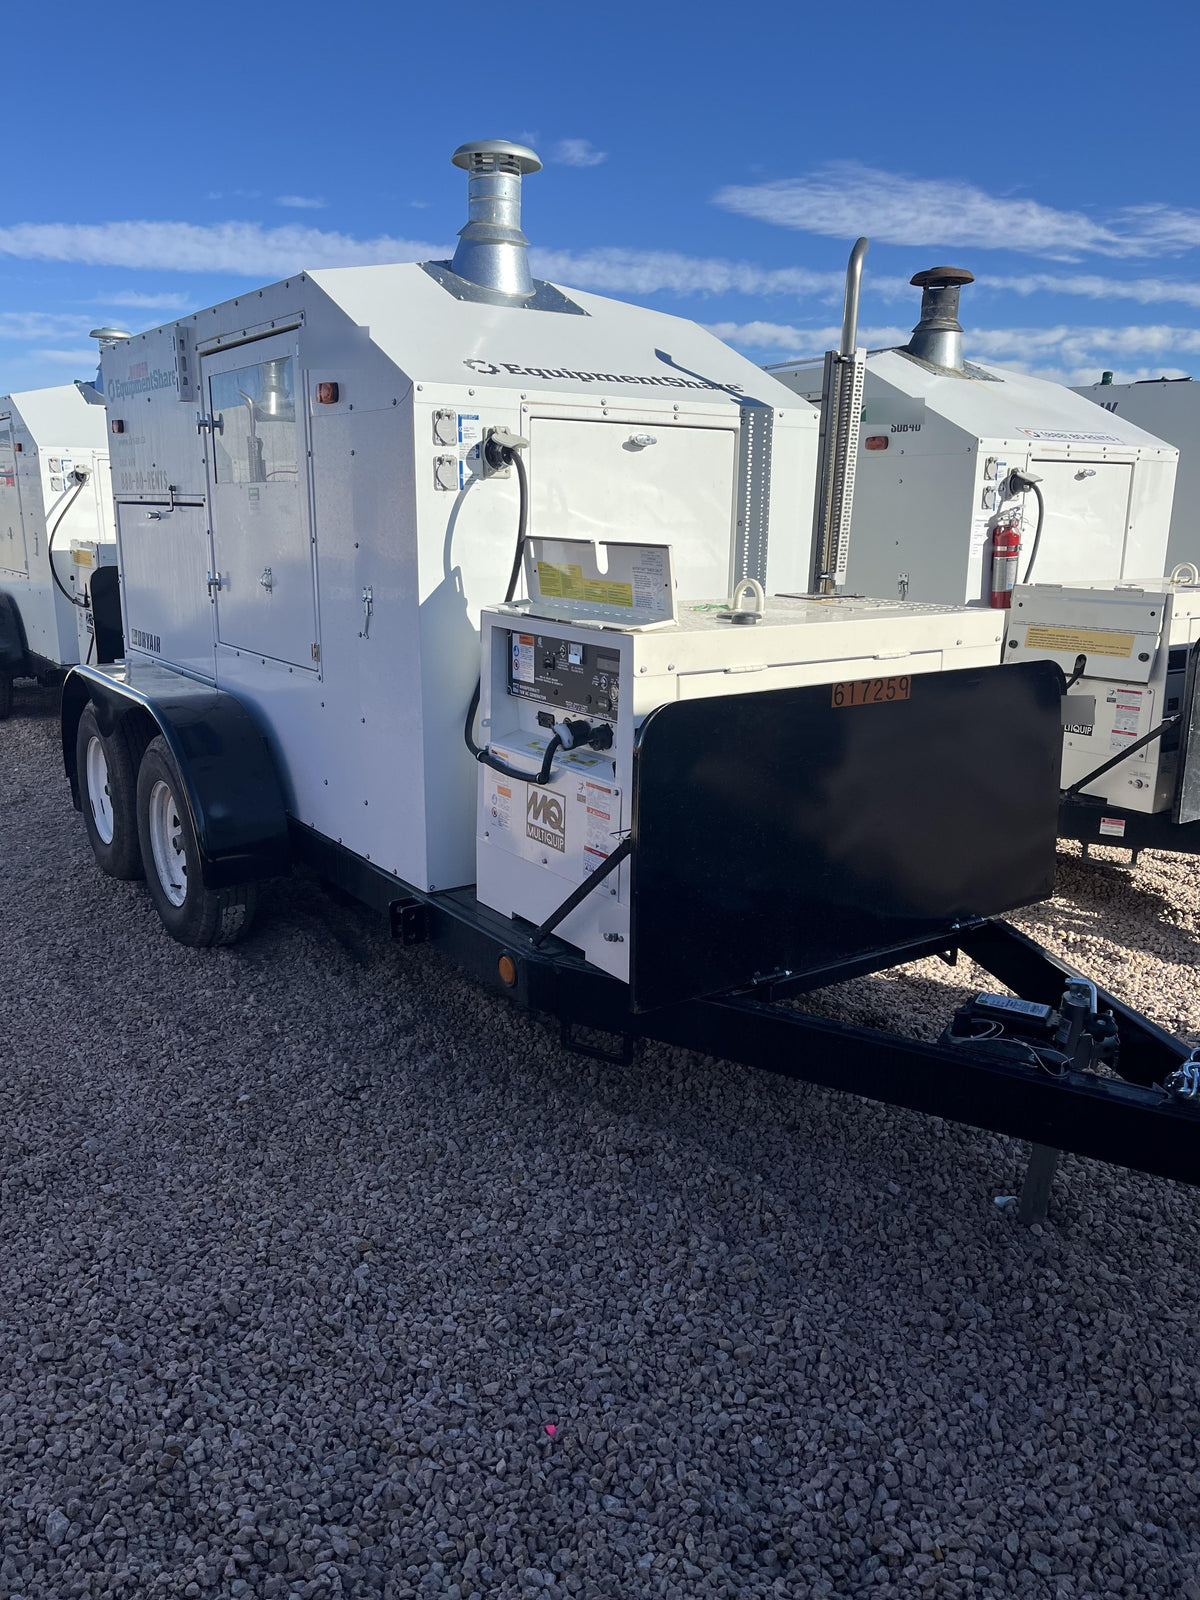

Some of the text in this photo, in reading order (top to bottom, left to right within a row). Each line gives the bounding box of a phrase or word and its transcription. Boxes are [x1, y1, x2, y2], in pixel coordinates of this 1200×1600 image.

[115, 369, 177, 400] EquipmentShare
[500, 363, 744, 392] EquipmentShare
[138, 630, 161, 653] DRYAIR
[834, 676, 909, 706] 617259
[527, 791, 565, 834] MQ
[527, 825, 564, 850] MULTIQUIP
